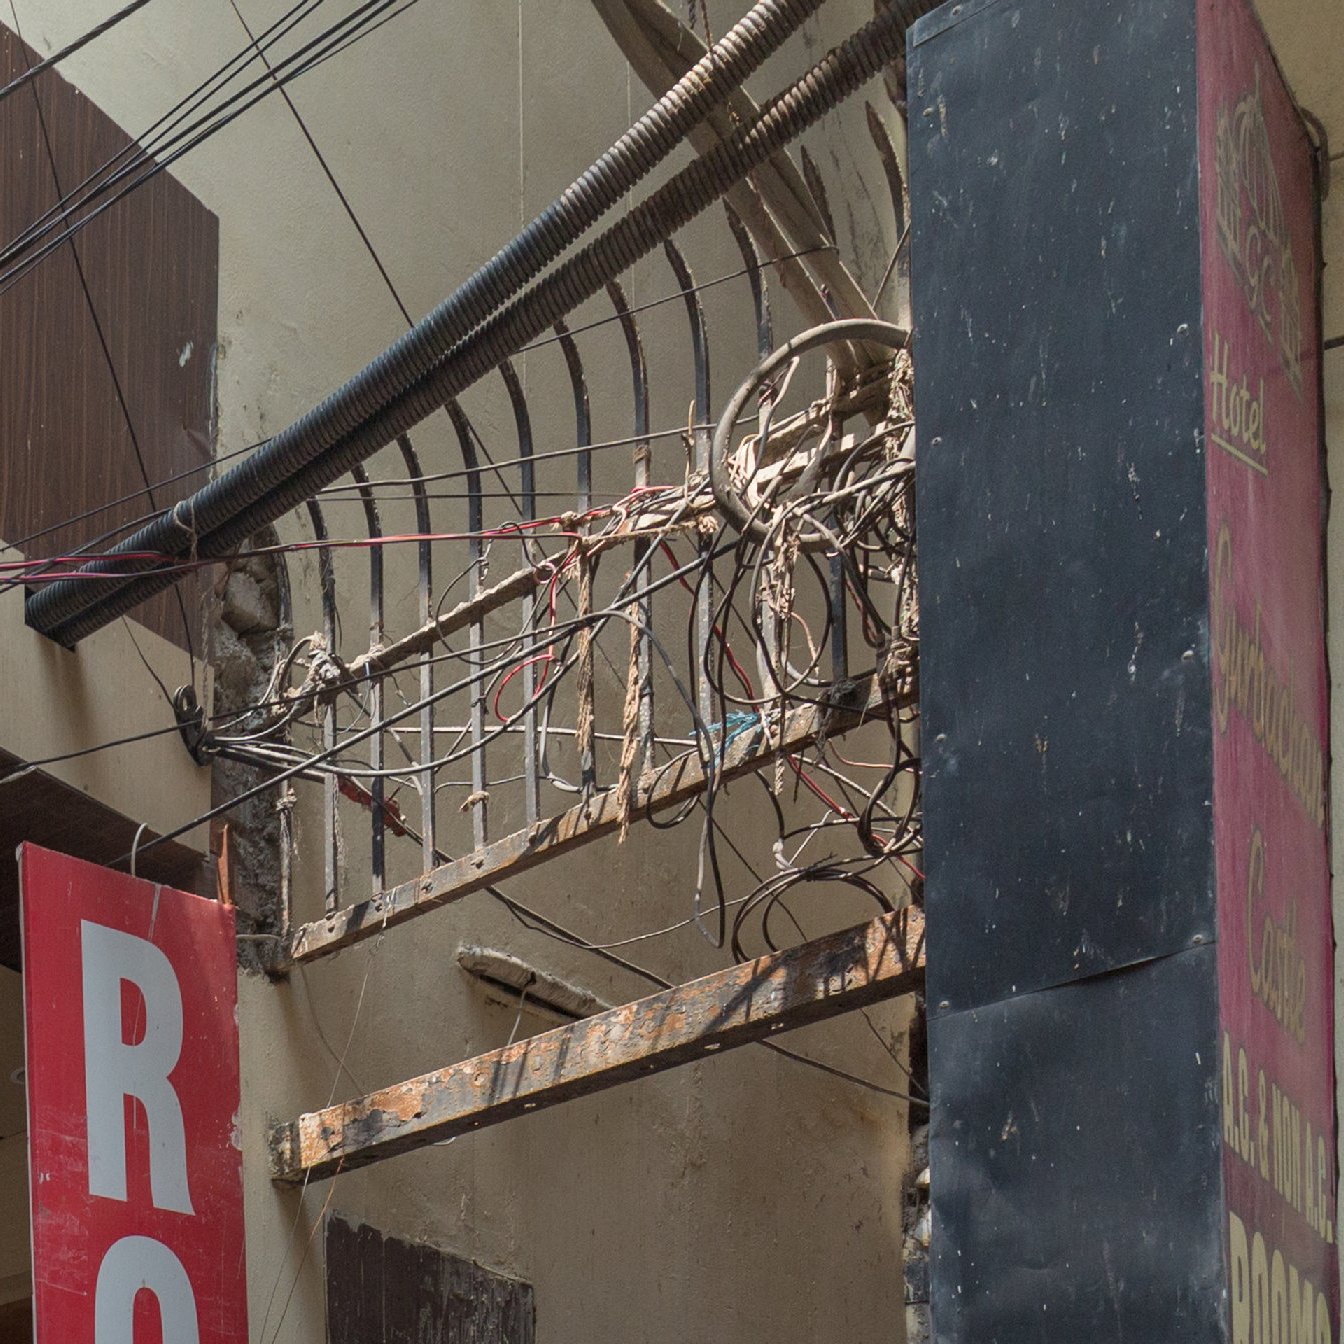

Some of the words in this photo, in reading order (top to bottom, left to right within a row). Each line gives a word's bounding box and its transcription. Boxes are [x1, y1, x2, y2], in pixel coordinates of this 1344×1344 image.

[1211, 331, 1265, 454] Hotel
[1222, 1032, 1255, 1169] A.C.
[1258, 1069, 1270, 1182] &
[1272, 1082, 1301, 1212] NON
[1305, 1122, 1334, 1244] A.C.
